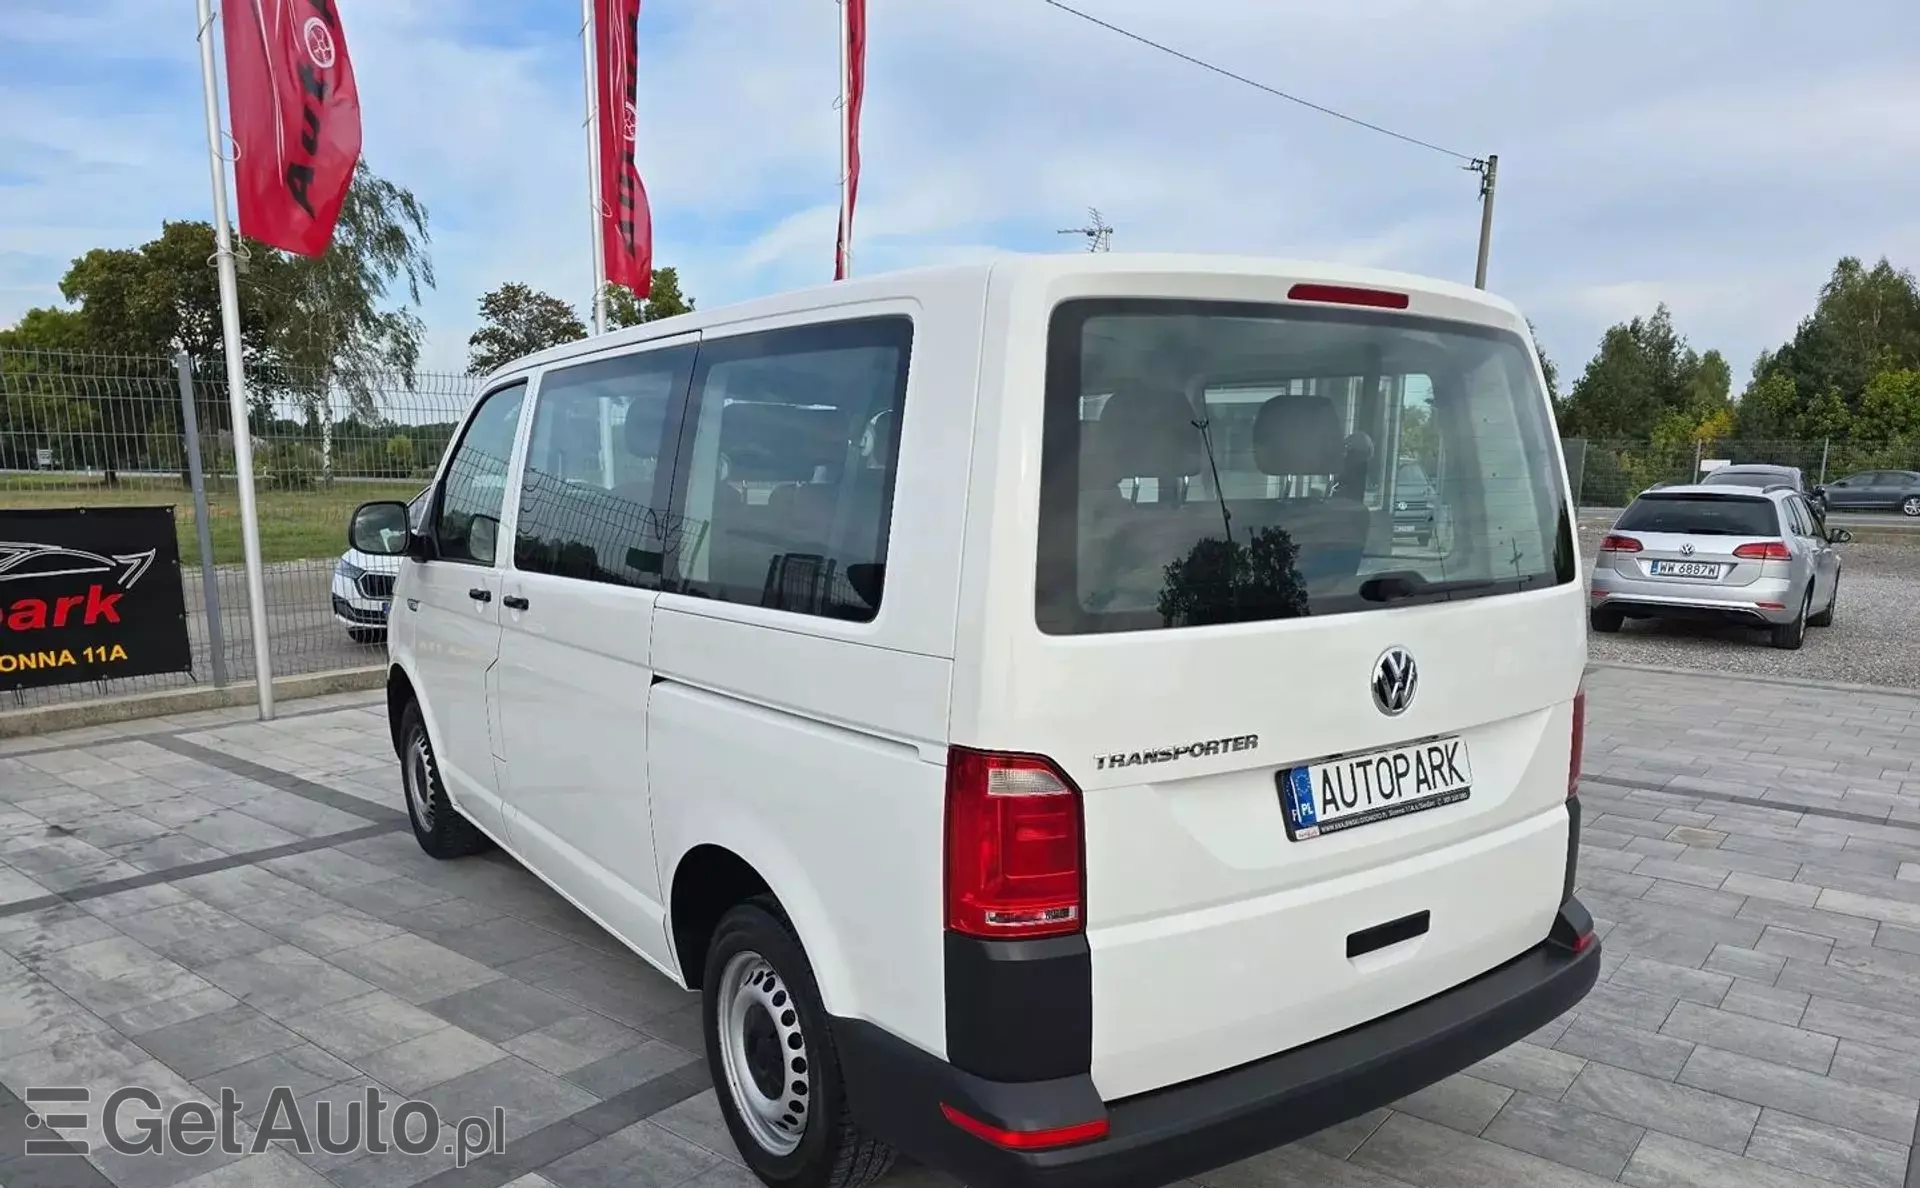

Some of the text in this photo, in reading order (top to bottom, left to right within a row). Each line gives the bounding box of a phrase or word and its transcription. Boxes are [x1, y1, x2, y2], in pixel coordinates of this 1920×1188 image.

[0, 584, 124, 631] ark
[83, 644, 128, 663] 11A
[1094, 734, 1259, 770] TRANSPORTER
[1321, 741, 1466, 815] AUTOPARK
